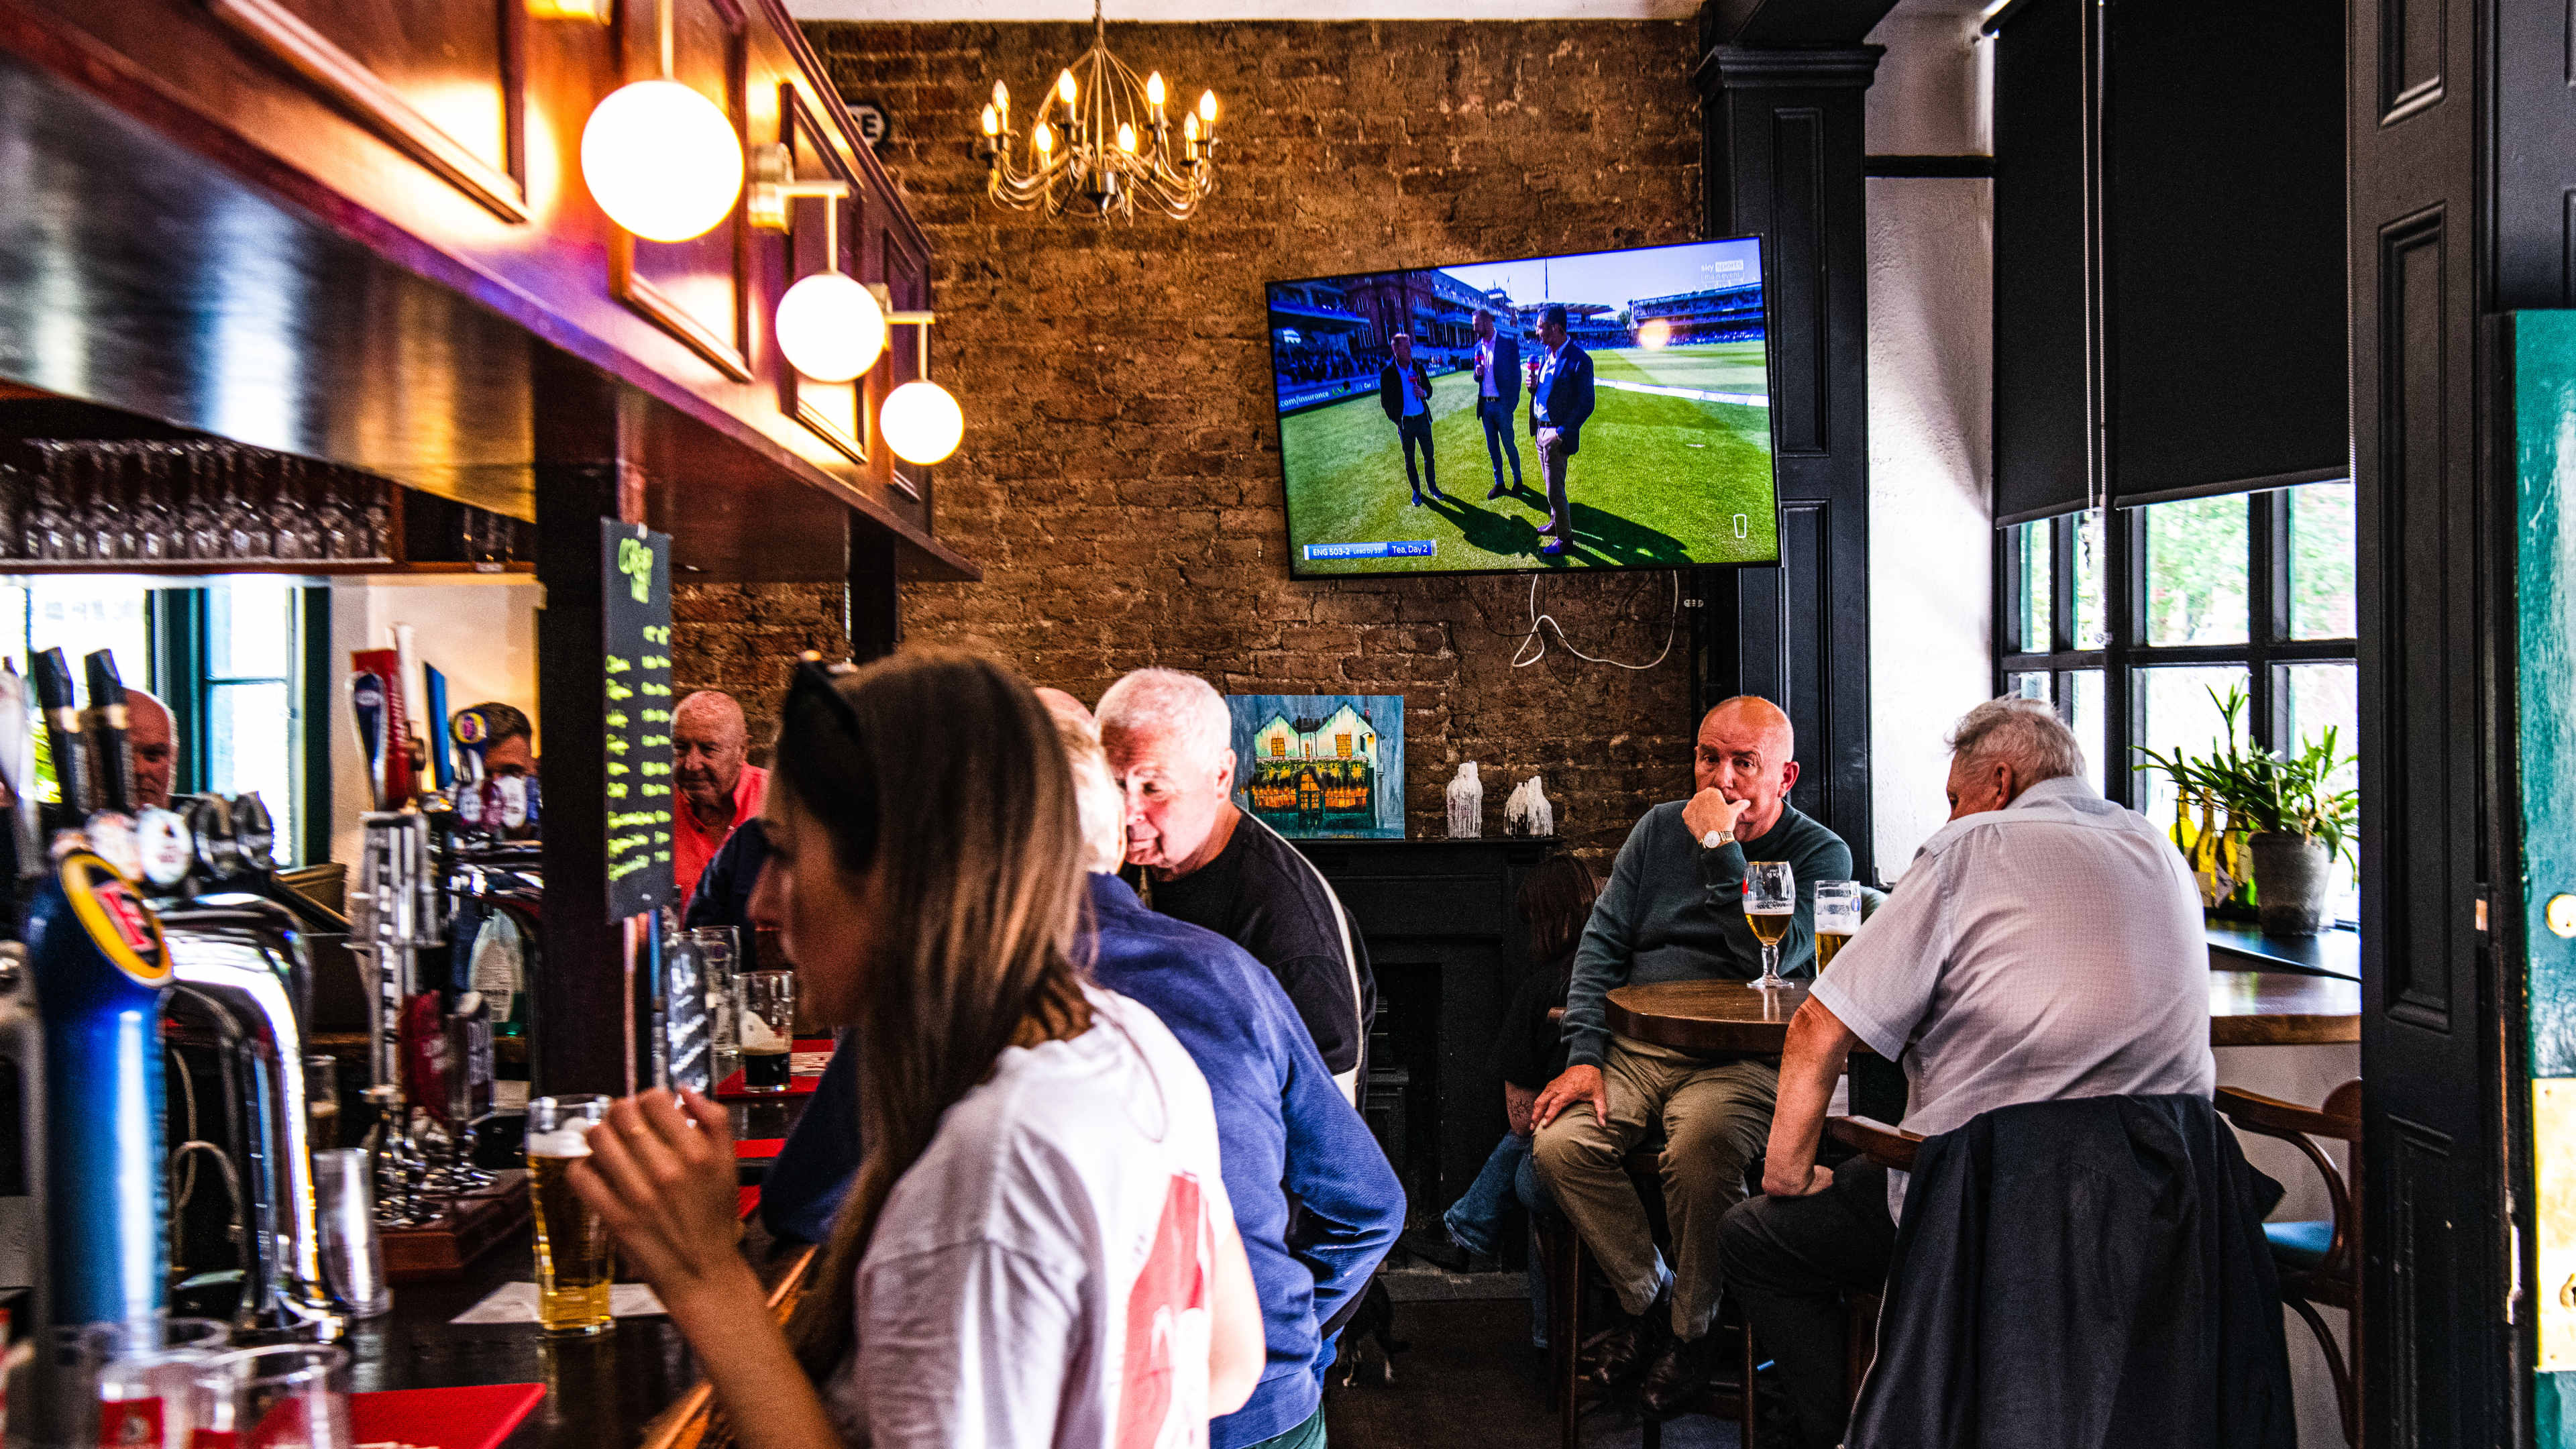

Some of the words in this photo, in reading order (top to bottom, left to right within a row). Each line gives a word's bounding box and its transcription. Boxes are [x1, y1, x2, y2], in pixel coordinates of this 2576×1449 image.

[1313, 548, 1328, 556] ENG
[1329, 547, 1350, 555] 503-2
[1392, 545, 1407, 554] Tea,
[1408, 545, 1421, 555] Day
[1423, 544, 1428, 553] 2
